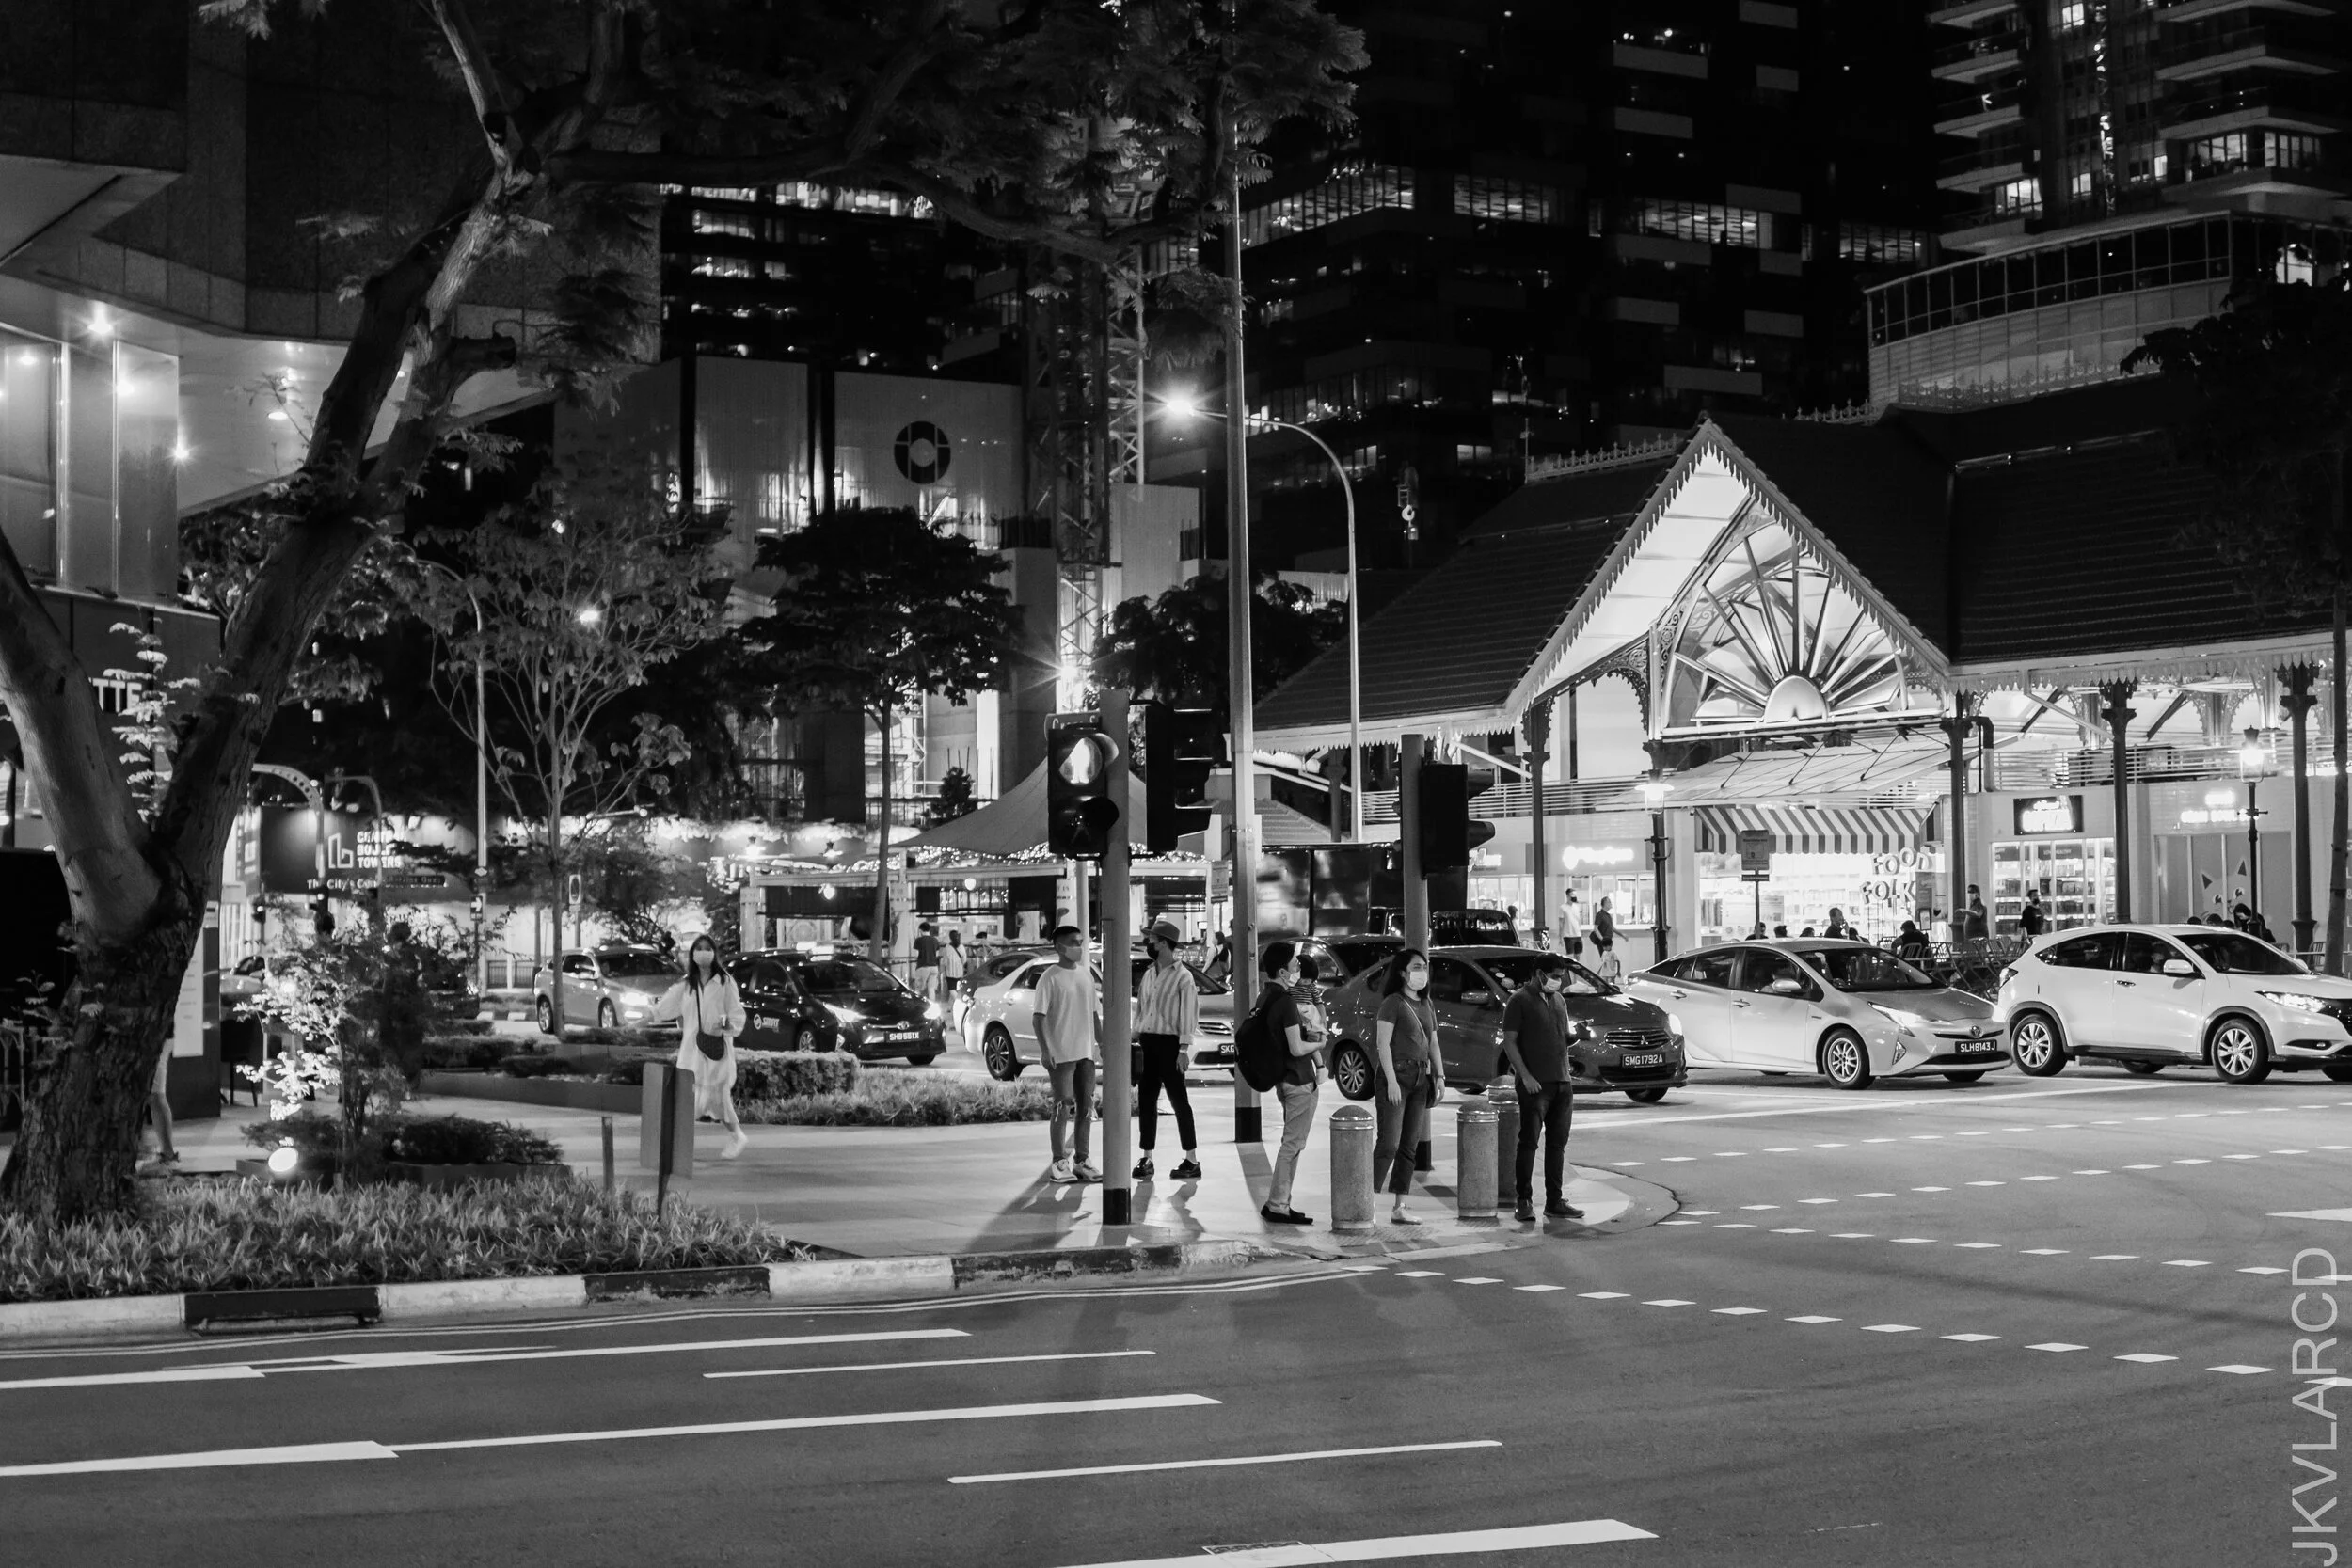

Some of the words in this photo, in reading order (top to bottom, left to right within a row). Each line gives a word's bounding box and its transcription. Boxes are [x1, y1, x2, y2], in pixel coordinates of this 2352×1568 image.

[88, 677, 142, 713] TTE
[1872, 847, 1932, 875] FOOD
[307, 879, 322, 890] Th
[1860, 878, 1916, 904] FOLK
[1960, 1042, 1995, 1053] SLH8143J
[1625, 1054, 1663, 1066] SMG1792A
